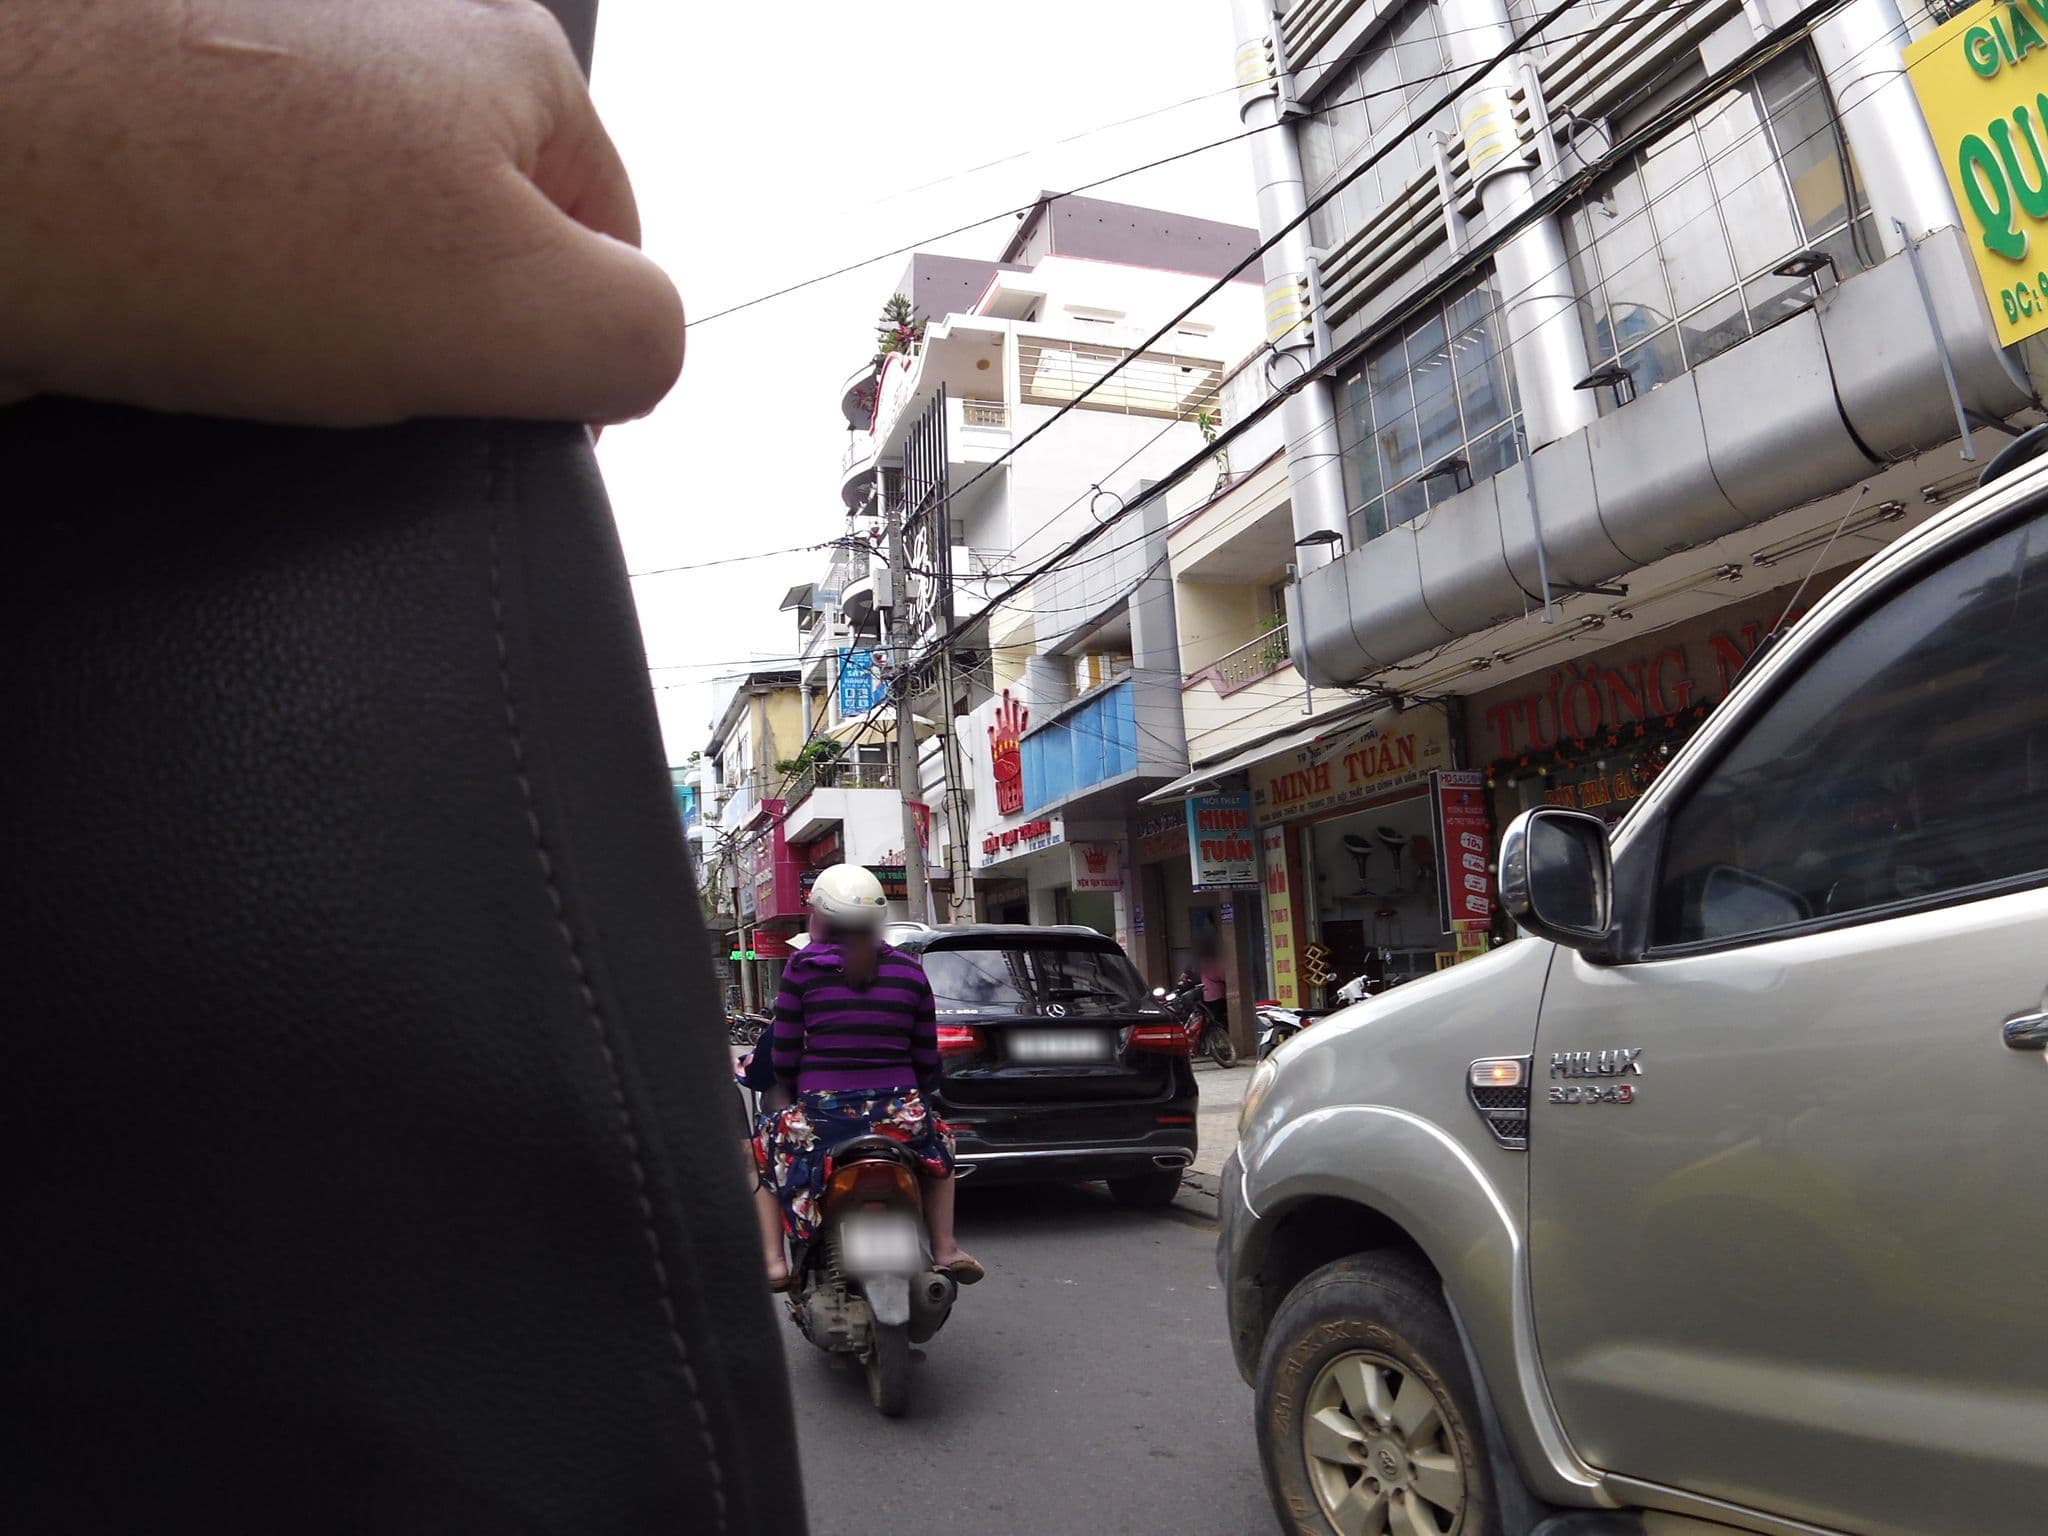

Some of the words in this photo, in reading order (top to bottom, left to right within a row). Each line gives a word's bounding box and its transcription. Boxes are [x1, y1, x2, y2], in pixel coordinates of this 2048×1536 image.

[1486, 648, 1694, 760] TƯỜNG
[1269, 762, 1330, 805] MINH
[1550, 1047, 1644, 1079] HILUX
